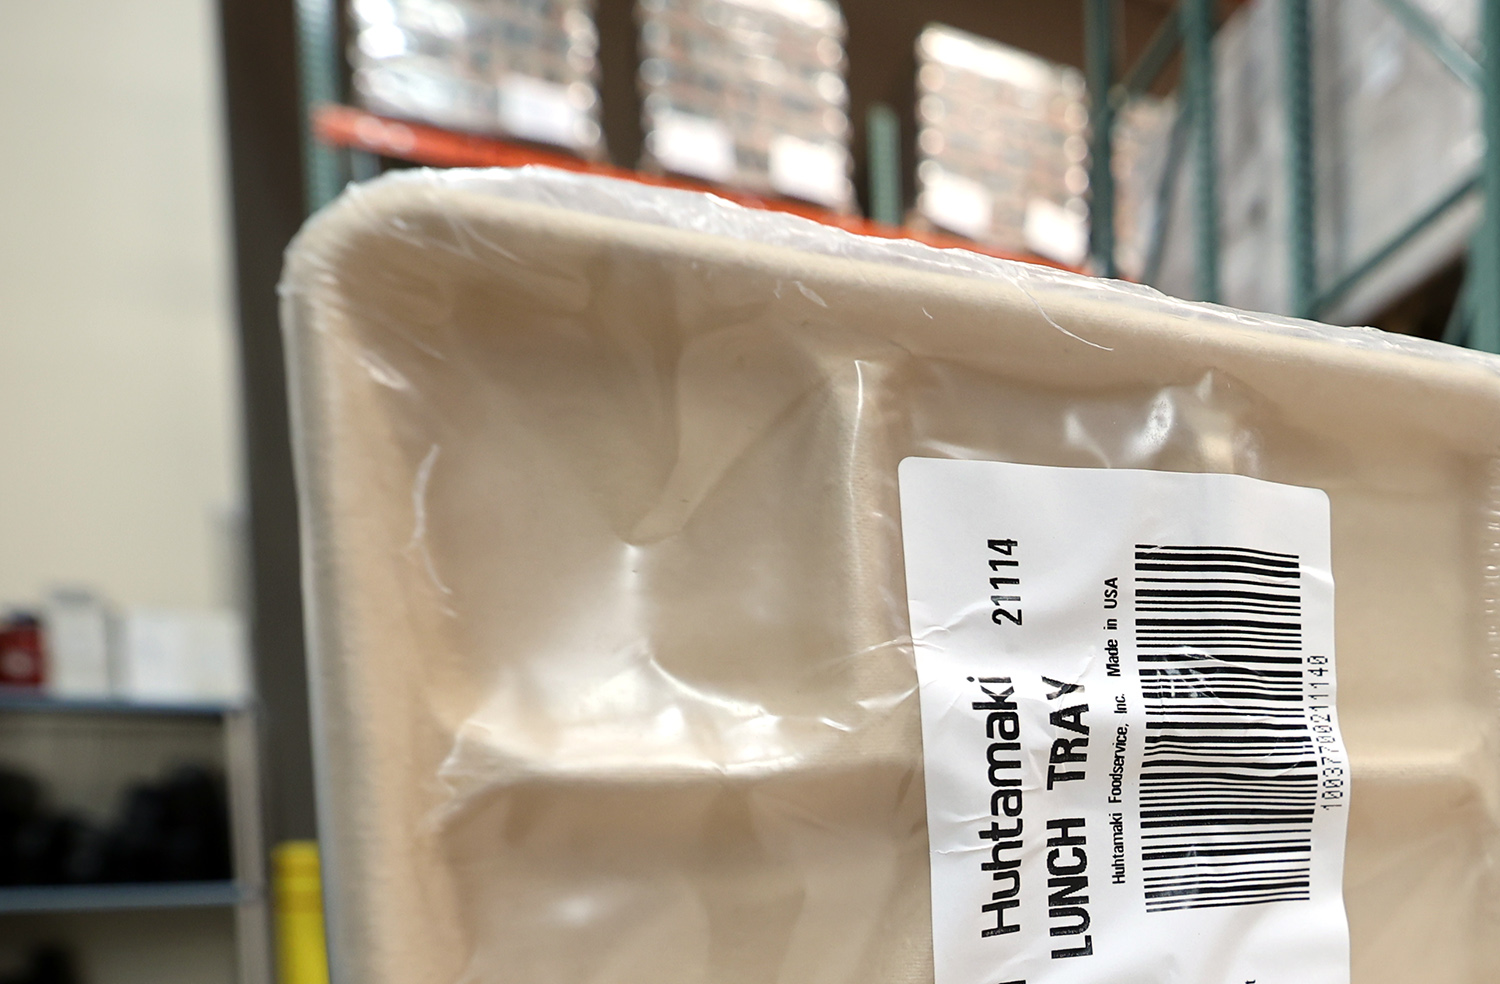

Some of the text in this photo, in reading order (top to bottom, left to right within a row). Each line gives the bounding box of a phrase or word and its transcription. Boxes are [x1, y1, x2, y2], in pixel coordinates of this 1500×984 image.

[987, 539, 1022, 625] 21114
[1041, 675, 1089, 790] TRAY
[1103, 577, 1129, 884] Huhtamaki Foodservice, Inc. Made in USA
[1307, 655, 1343, 810] 10037700211140
[966, 676, 1023, 938] Huhtamaki
[1046, 818, 1093, 959] LUNCH
